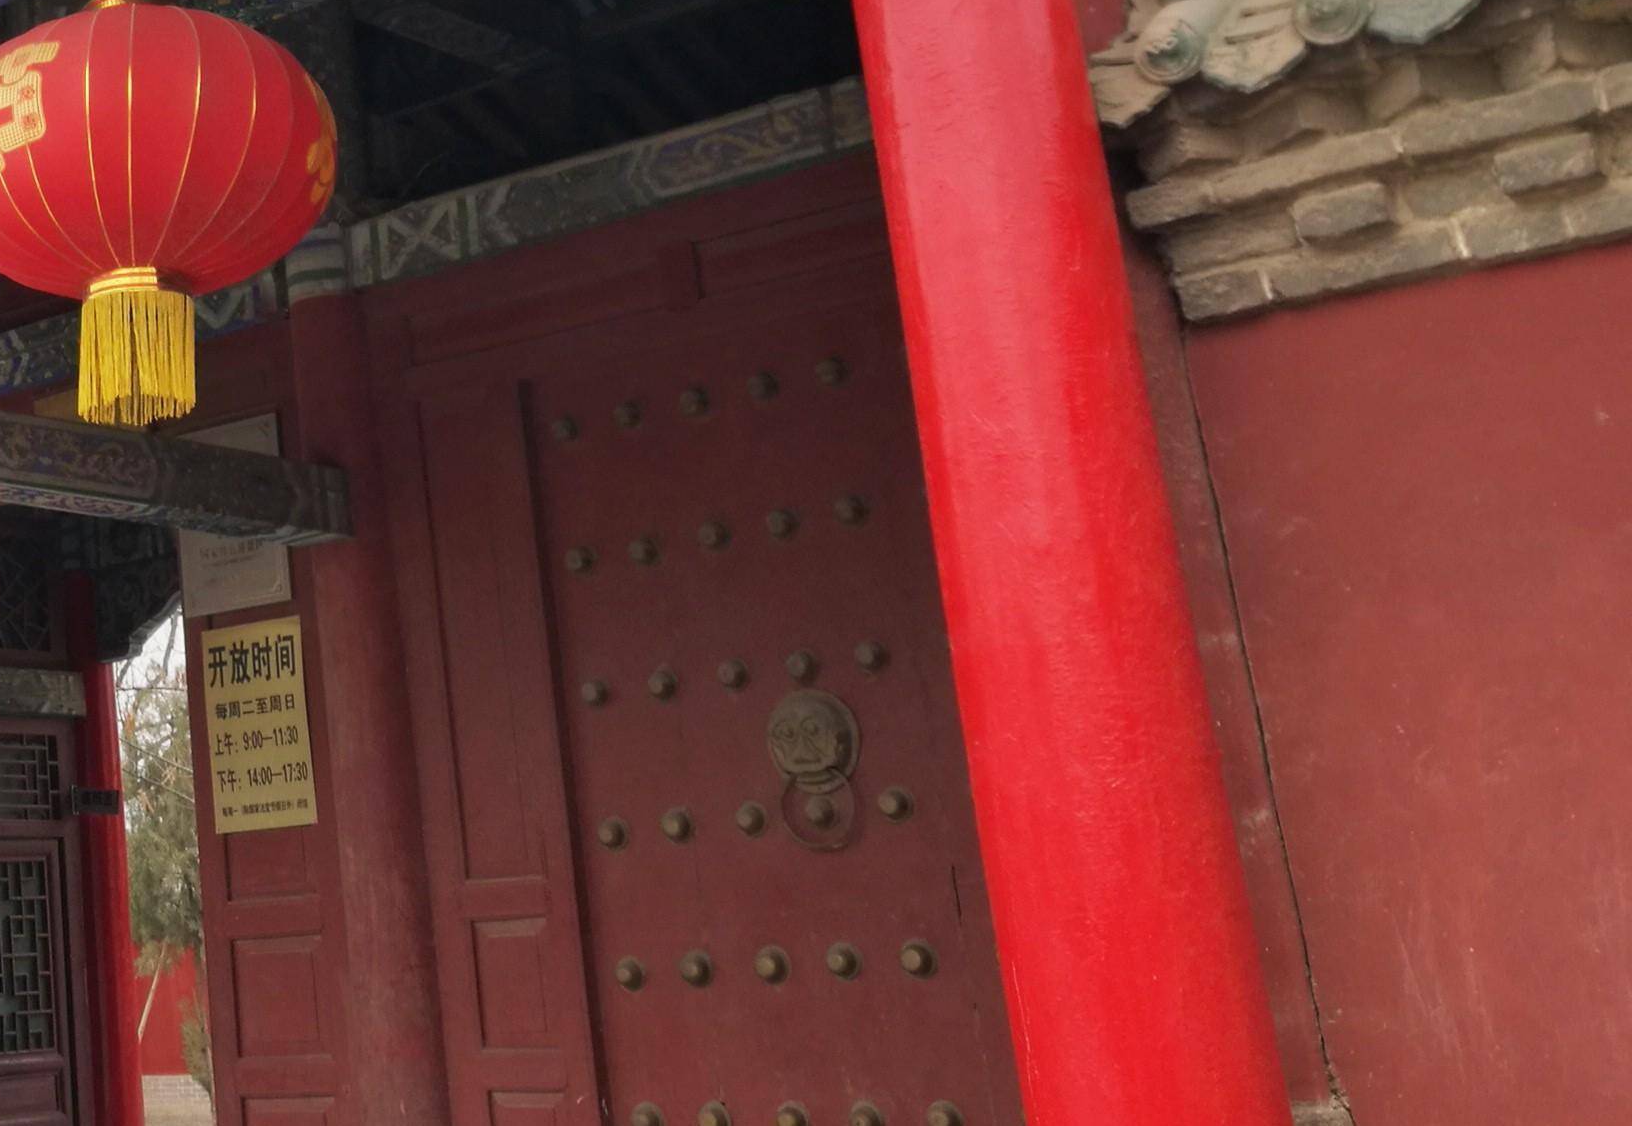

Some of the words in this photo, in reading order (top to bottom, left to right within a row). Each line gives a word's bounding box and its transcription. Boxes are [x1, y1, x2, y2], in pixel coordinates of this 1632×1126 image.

[208, 634, 296, 688] 开放时间
[215, 693, 296, 721] 每周二至周日
